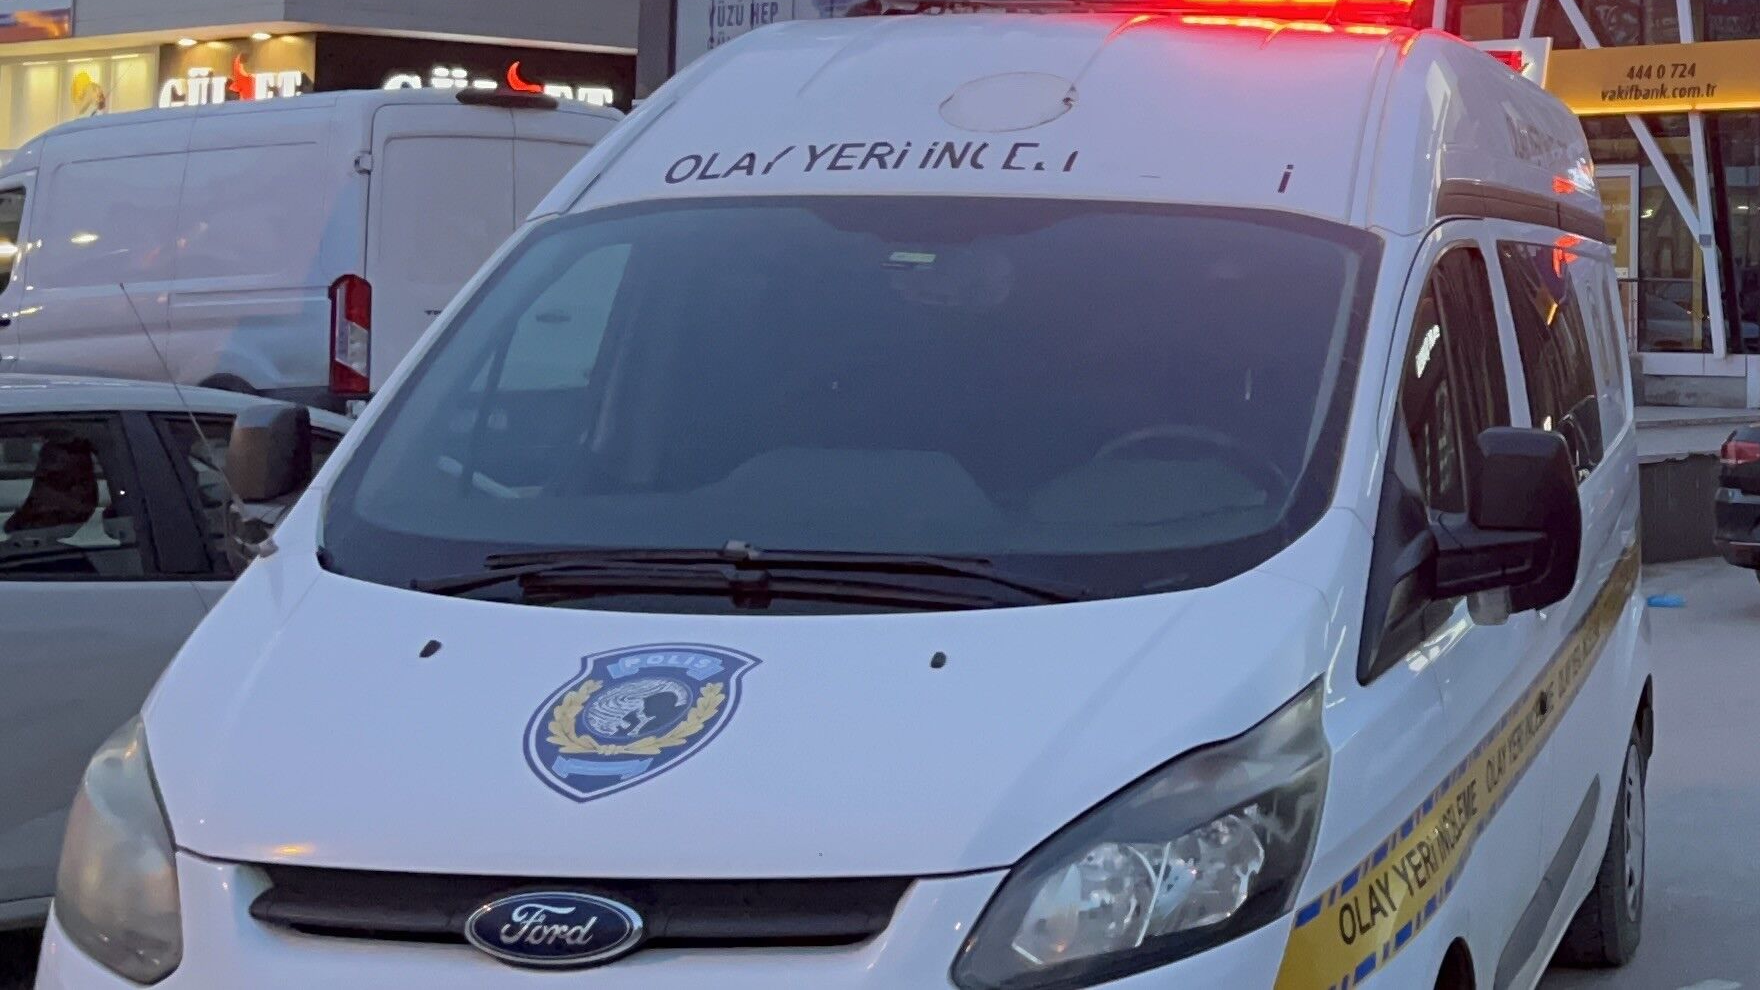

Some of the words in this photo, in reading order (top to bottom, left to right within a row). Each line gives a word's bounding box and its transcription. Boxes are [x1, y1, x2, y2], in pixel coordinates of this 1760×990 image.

[751, 1, 779, 25] HEP
[1626, 64, 1653, 81] 444
[1656, 64, 1666, 80] 0
[1670, 62, 1697, 80] 724
[500, 903, 598, 945] Ford
[1338, 871, 1397, 946] OLAY
